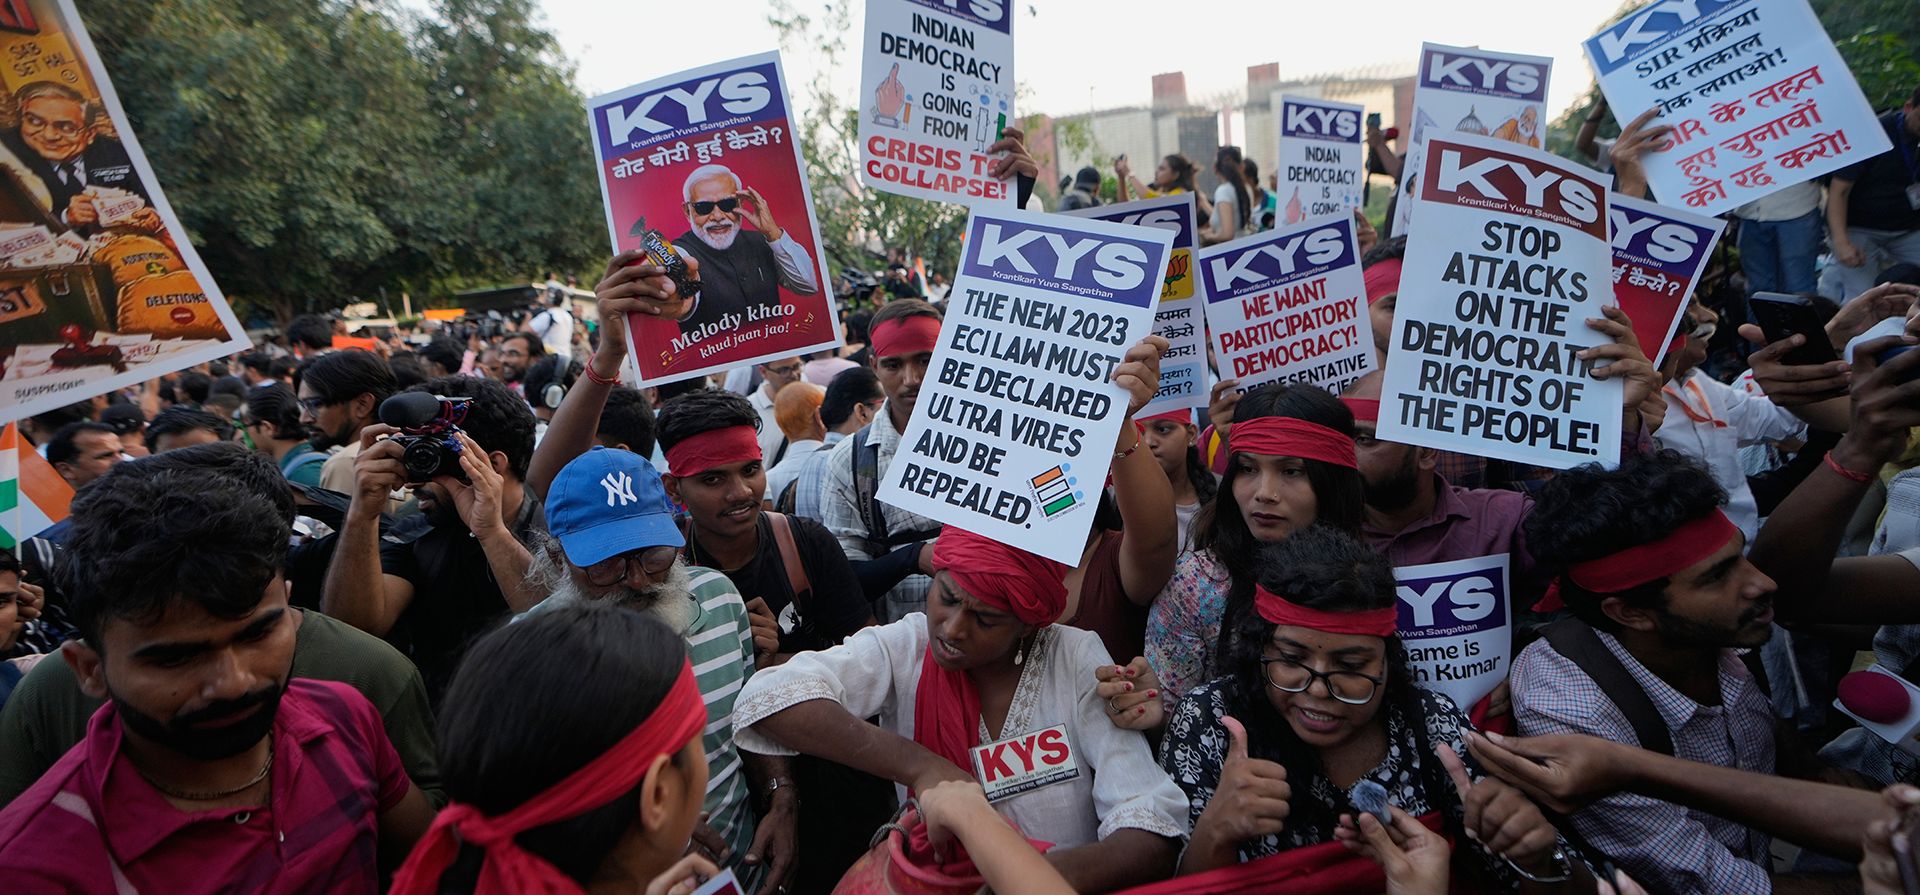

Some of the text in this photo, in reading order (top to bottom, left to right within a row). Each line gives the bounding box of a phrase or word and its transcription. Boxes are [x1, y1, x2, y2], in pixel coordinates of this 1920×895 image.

[912, 12, 975, 50] INDIAN
[1599, 0, 1727, 64] KY
[1635, 7, 1760, 79] SIR प्रक्रिया
[880, 32, 1001, 84] DEMOCRACY
[1429, 53, 1540, 94] KYS
[1651, 32, 1763, 92] पर तत्काल
[1694, 48, 1788, 98] लगाओ!
[941, 73, 955, 91] IS
[1708, 99, 1746, 123] के
[1748, 65, 1824, 108] तहत
[606, 72, 771, 147] KYS
[922, 92, 972, 119] GOING
[1287, 104, 1357, 138] KYS
[631, 115, 752, 149] Krantikari Yuva Sangathan
[923, 116, 969, 141] FROM
[1719, 99, 1823, 159] चुनावों
[612, 157, 644, 178] वोट
[649, 141, 690, 168] चोरी
[694, 134, 723, 163] हुई
[867, 135, 961, 172] CRISIS
[1288, 166, 1356, 185] DEMOCRACY
[1305, 146, 1340, 163] INDIAN
[1681, 176, 1728, 208] को
[1774, 129, 1851, 170] करो!
[867, 160, 1007, 200] COLLAPSE!
[1322, 186, 1330, 199] IS
[1438, 149, 1599, 224] KYS
[1312, 202, 1340, 216] GOING
[1457, 195, 1582, 229] Krantikari Yuva Sangathan
[646, 234, 676, 267] Melody
[977, 223, 1148, 291] KYS
[1481, 220, 1561, 260] STOP
[1611, 208, 1699, 263] YS
[1211, 228, 1344, 292] KYS
[1234, 265, 1329, 296] Krantikari Yuva Sangathan
[1442, 251, 1588, 302] ATTACKS
[1616, 250, 1663, 268] Sangathan
[146, 293, 208, 307] DELETIONS
[992, 270, 1113, 299] Krantikari Yuva Sangathan
[1242, 278, 1327, 320] WE WANT
[670, 300, 796, 354] Melody khao
[964, 288, 1129, 346] THE NEW 2023
[1155, 308, 1191, 322] ल्पमत
[1163, 323, 1195, 339] कैसे
[1219, 296, 1358, 354] PARTICIPATORY
[1455, 290, 1570, 337] ON THE
[699, 321, 790, 360] khud jaan jao!
[950, 324, 1121, 385] ECI LAW MUST
[1232, 325, 1359, 378] DEMOCRACY!
[938, 357, 1112, 421] BE DECLARED
[1418, 359, 1584, 414] RIGHTS OF
[927, 392, 1085, 458] ULTRA VIRES
[1398, 393, 1600, 456] THE PEOPLE!
[913, 428, 1007, 477] AND BE
[600, 471, 637, 507] NY
[899, 462, 1032, 530] REPEALED.
[1396, 576, 1496, 626] YS
[1399, 623, 1478, 638] Yuva Sangathan
[1464, 639, 1480, 657] is
[1436, 655, 1501, 681] Kumar
[980, 729, 1069, 783] KYS
